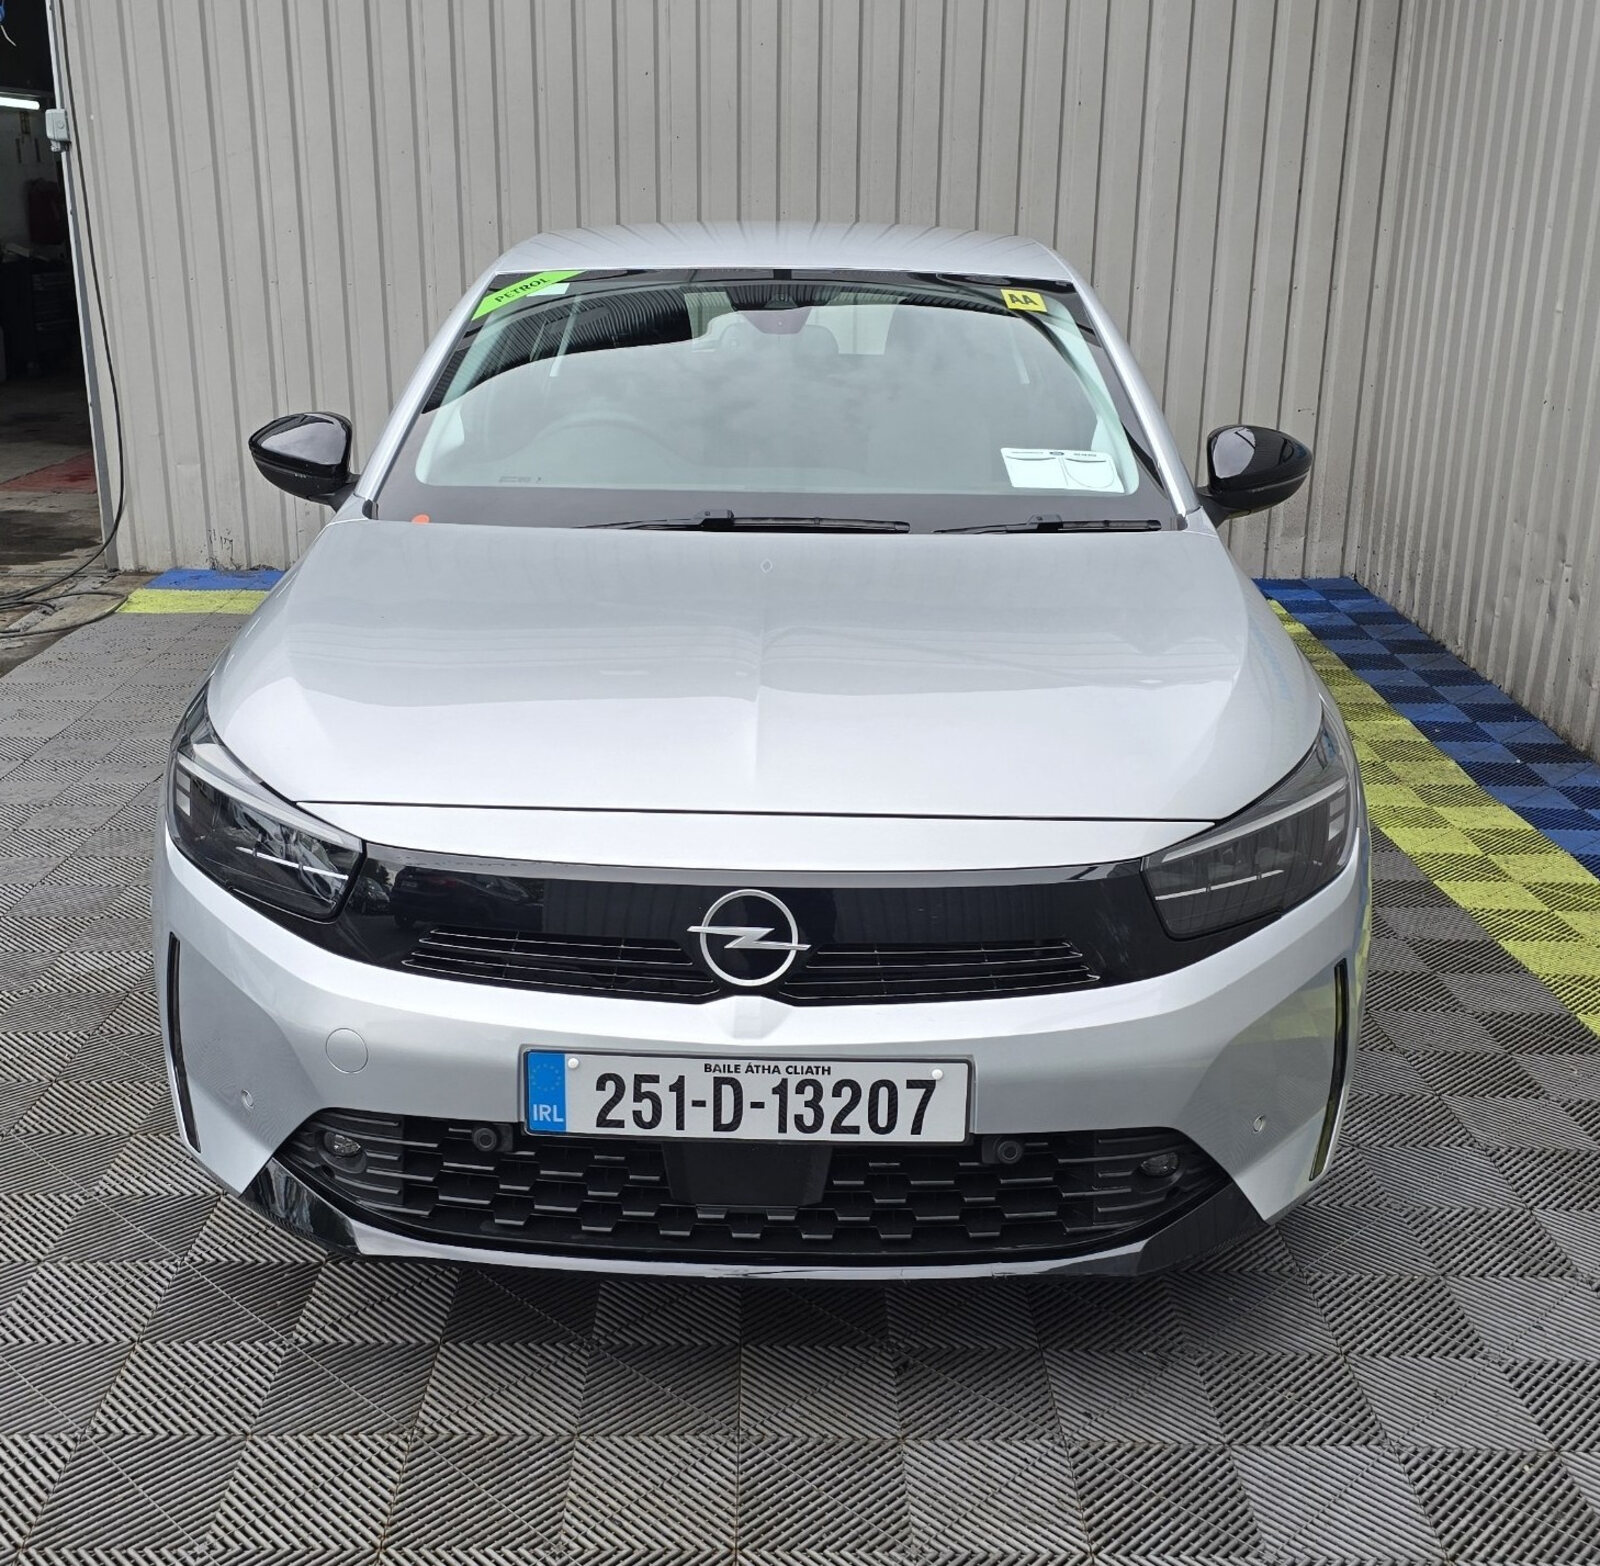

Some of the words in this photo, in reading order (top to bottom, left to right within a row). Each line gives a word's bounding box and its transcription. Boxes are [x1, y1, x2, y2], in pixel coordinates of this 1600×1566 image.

[494, 278, 550, 302] PETROL
[1008, 293, 1039, 306] AA
[704, 1063, 742, 1074] BAILE
[745, 1061, 781, 1074] ÁTHA
[785, 1064, 831, 1075] CLIATH
[533, 1104, 564, 1123] IRL
[595, 1073, 937, 1135] 251-D-13207
